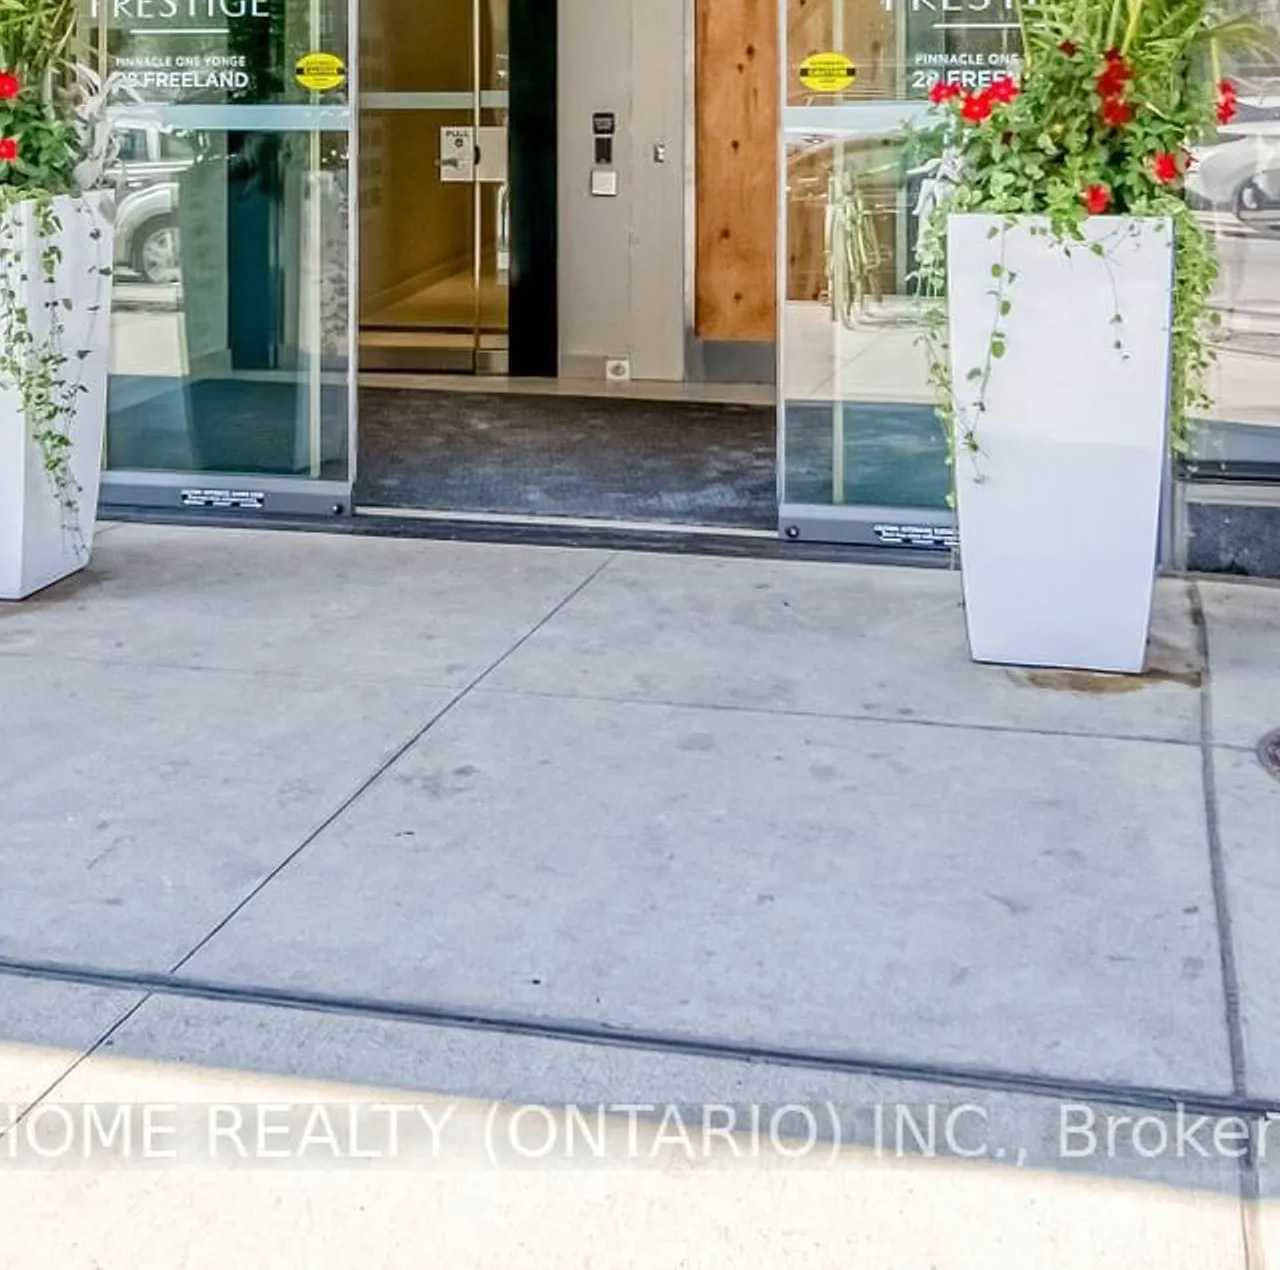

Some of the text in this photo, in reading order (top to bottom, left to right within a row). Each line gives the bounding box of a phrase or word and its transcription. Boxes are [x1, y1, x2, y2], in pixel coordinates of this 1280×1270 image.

[204, 55, 247, 67] YONGE
[915, 53, 985, 66] PINNACLE
[143, 70, 250, 88] FREELAND
